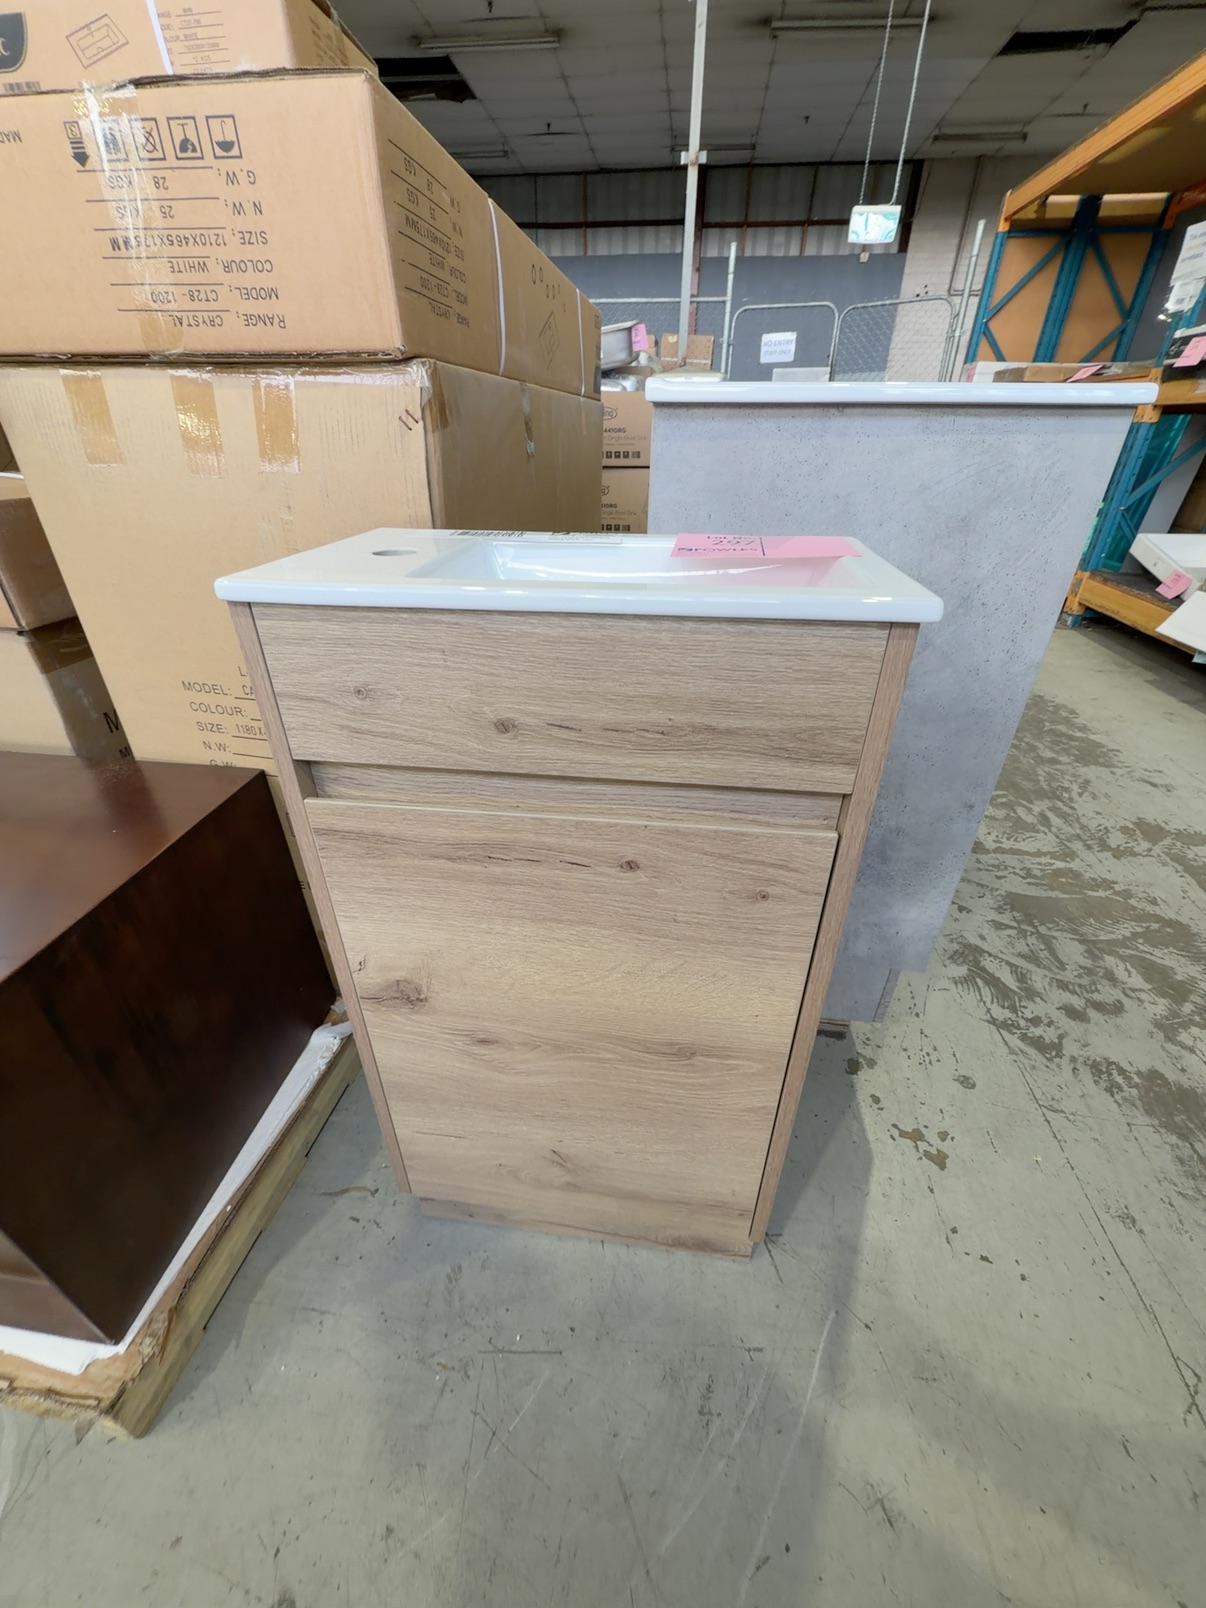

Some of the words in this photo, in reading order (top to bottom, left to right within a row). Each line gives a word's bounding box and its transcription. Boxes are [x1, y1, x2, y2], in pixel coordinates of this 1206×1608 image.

[152, 175, 169, 191] 28
[159, 204, 175, 219] 25
[168, 260, 210, 274] WHITE
[168, 314, 224, 328] CRYSTAL
[774, 339, 795, 347] ENTRY
[181, 680, 233, 697] MODEL:
[189, 701, 249, 718] COLOUR:
[196, 721, 230, 735] SIZE:
[235, 723, 267, 737] 1180X
[202, 740, 232, 753] N.W:
